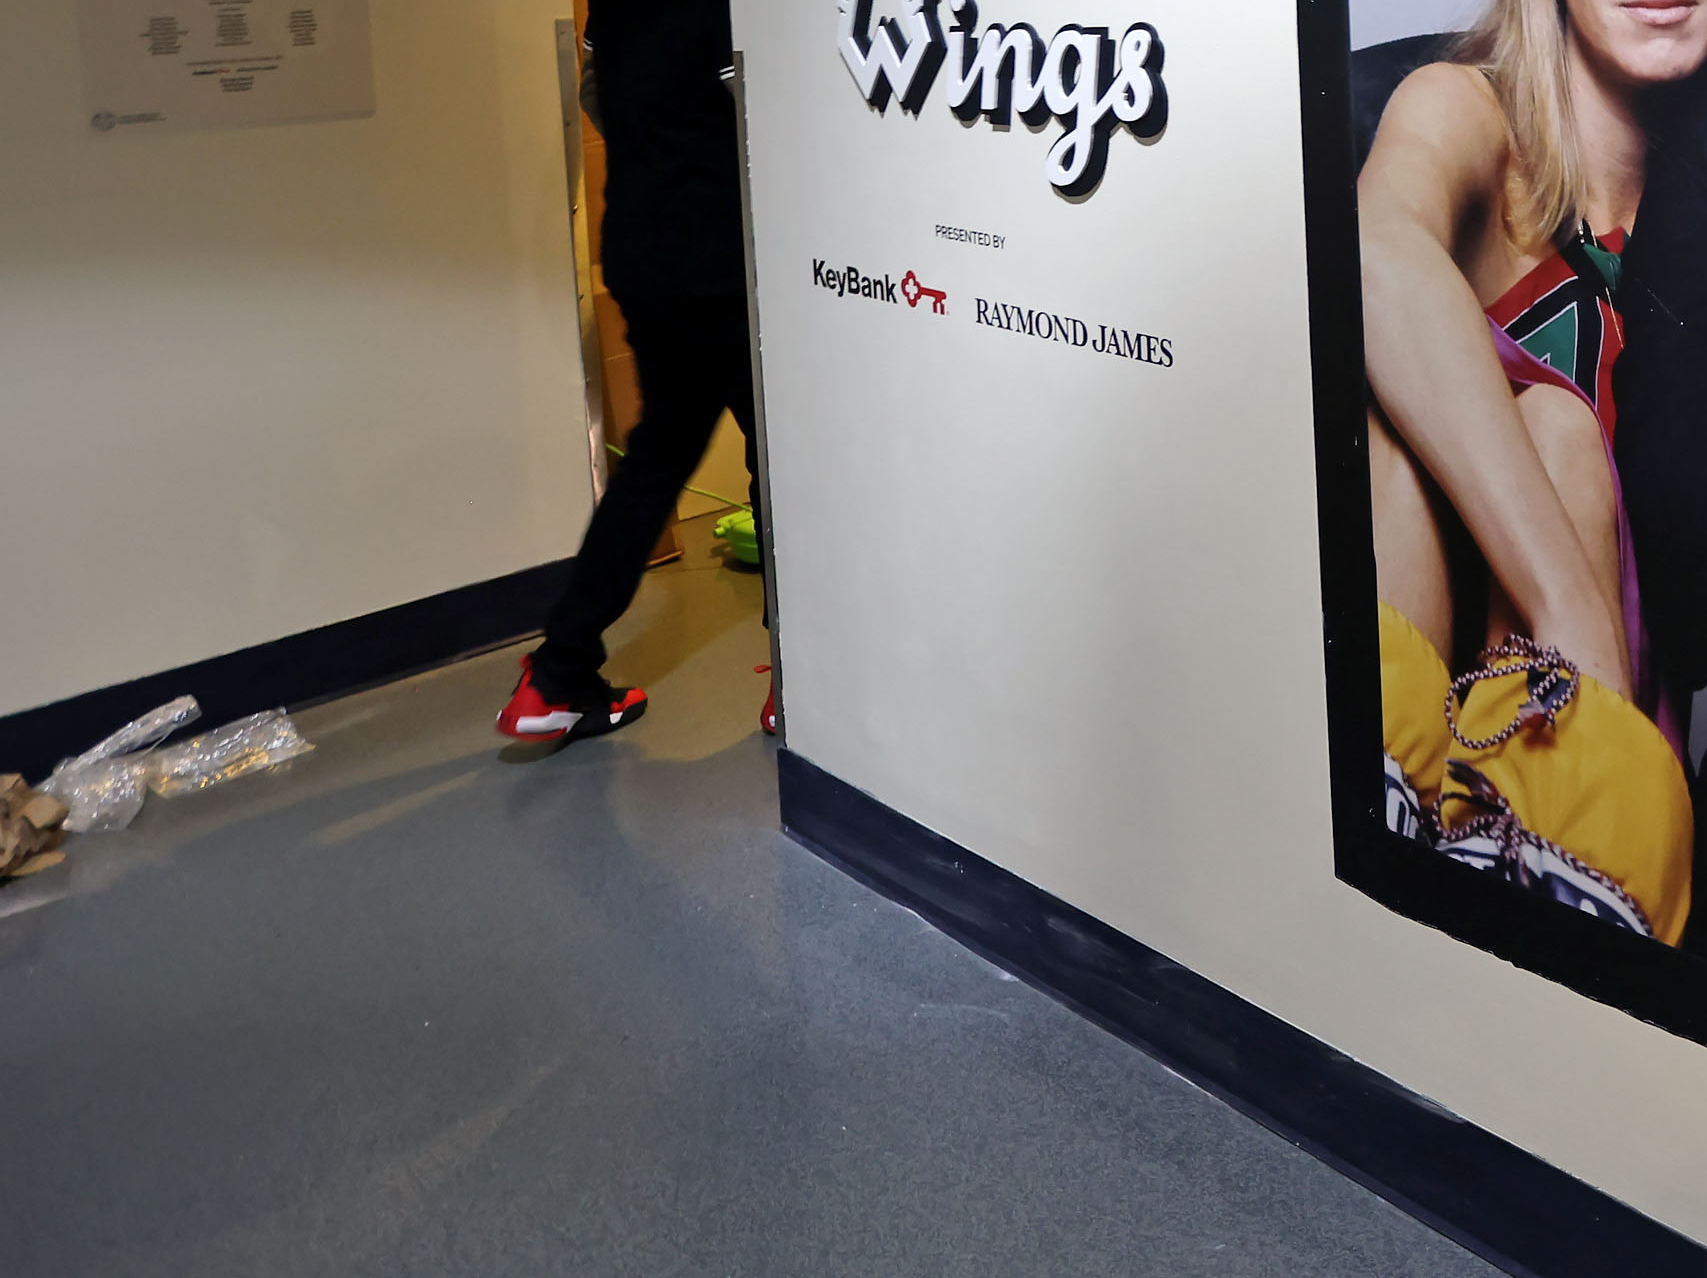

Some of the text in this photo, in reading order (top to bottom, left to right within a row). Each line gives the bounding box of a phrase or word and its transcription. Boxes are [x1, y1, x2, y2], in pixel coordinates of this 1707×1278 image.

[935, 224, 1006, 249] PRESENTED BY
[811, 258, 897, 304] KeyBank
[974, 297, 1174, 368] RAYMOND JAMES
